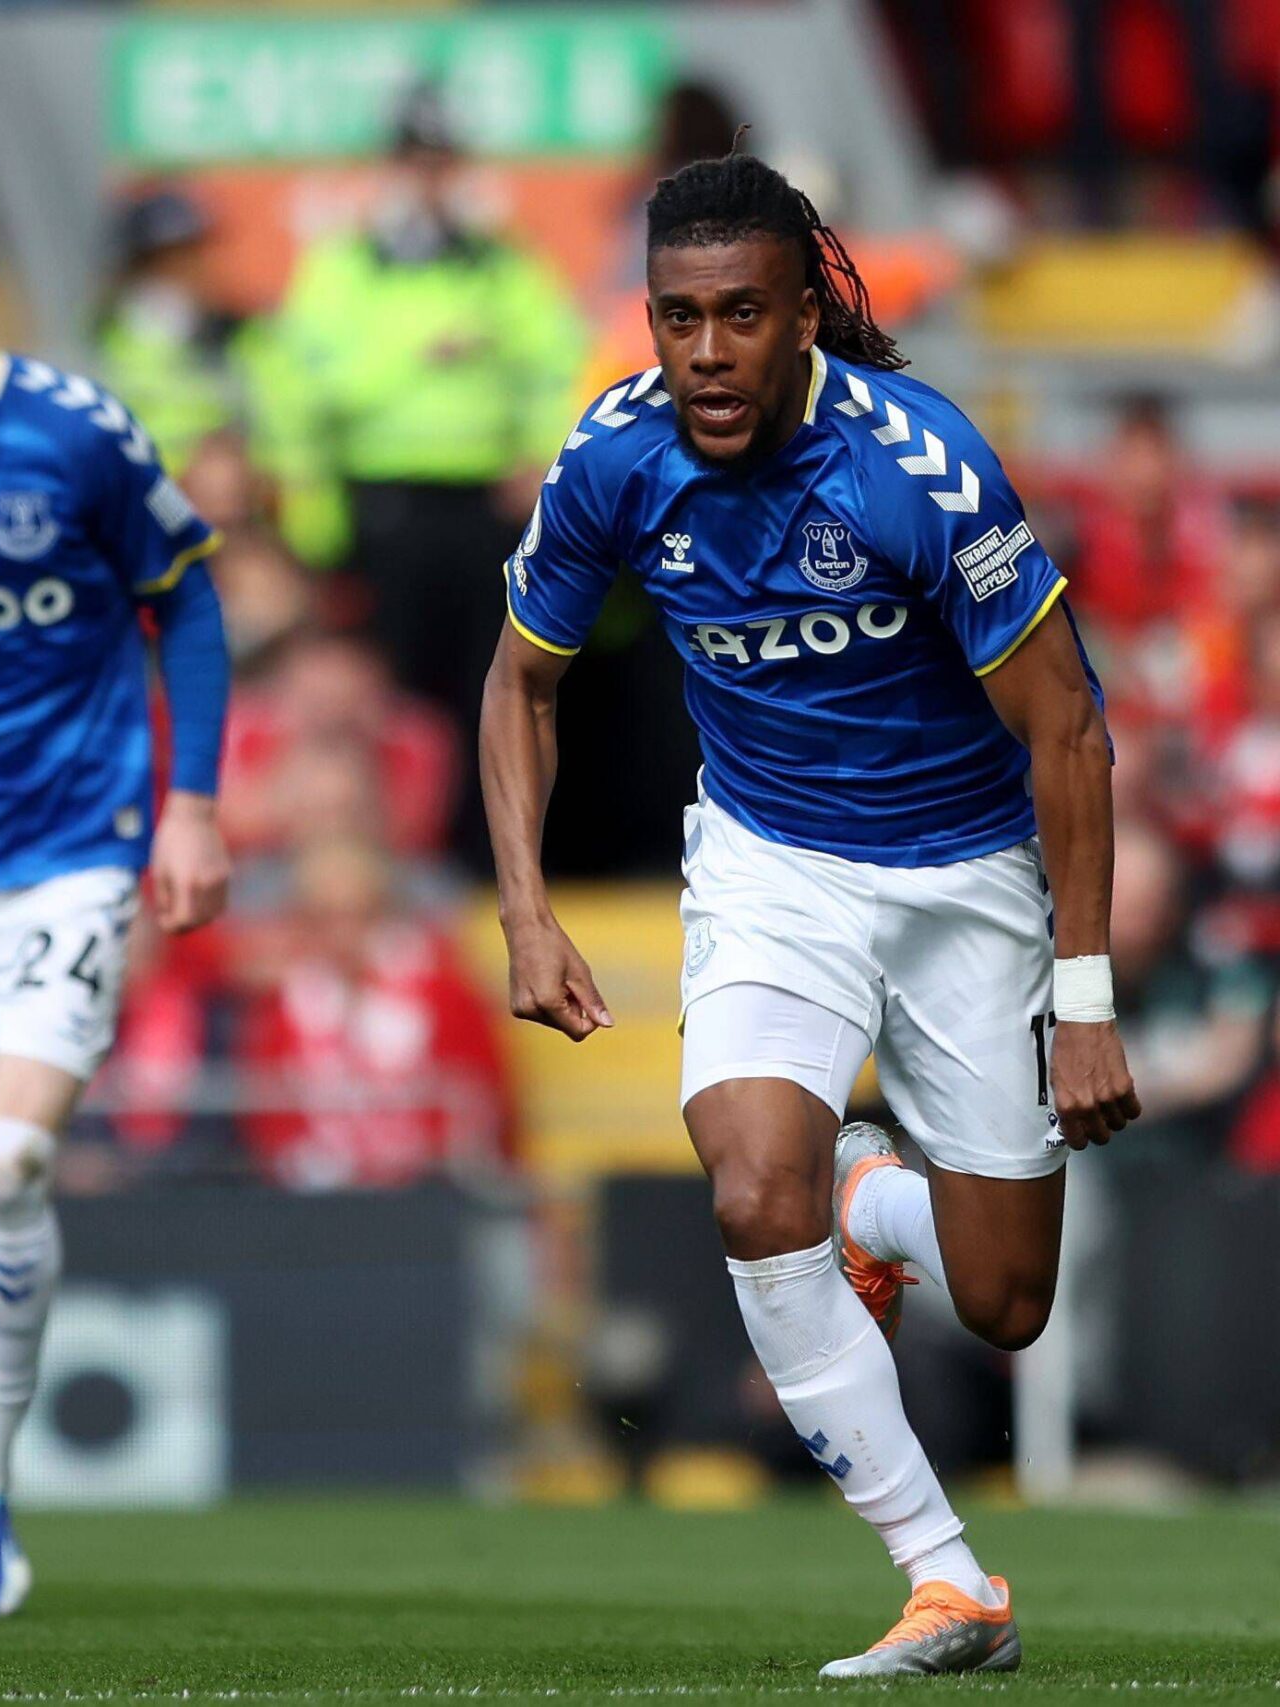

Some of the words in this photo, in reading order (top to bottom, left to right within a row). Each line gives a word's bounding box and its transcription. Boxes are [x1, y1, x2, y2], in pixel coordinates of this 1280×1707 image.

[815, 559, 850, 570] Everton
[960, 533, 1002, 568] UKRAINE
[967, 527, 1029, 582] HUMANITARIAN
[975, 566, 1012, 596] APPEAL
[680, 604, 908, 663] AZOO
[15, 930, 100, 1000] 24
